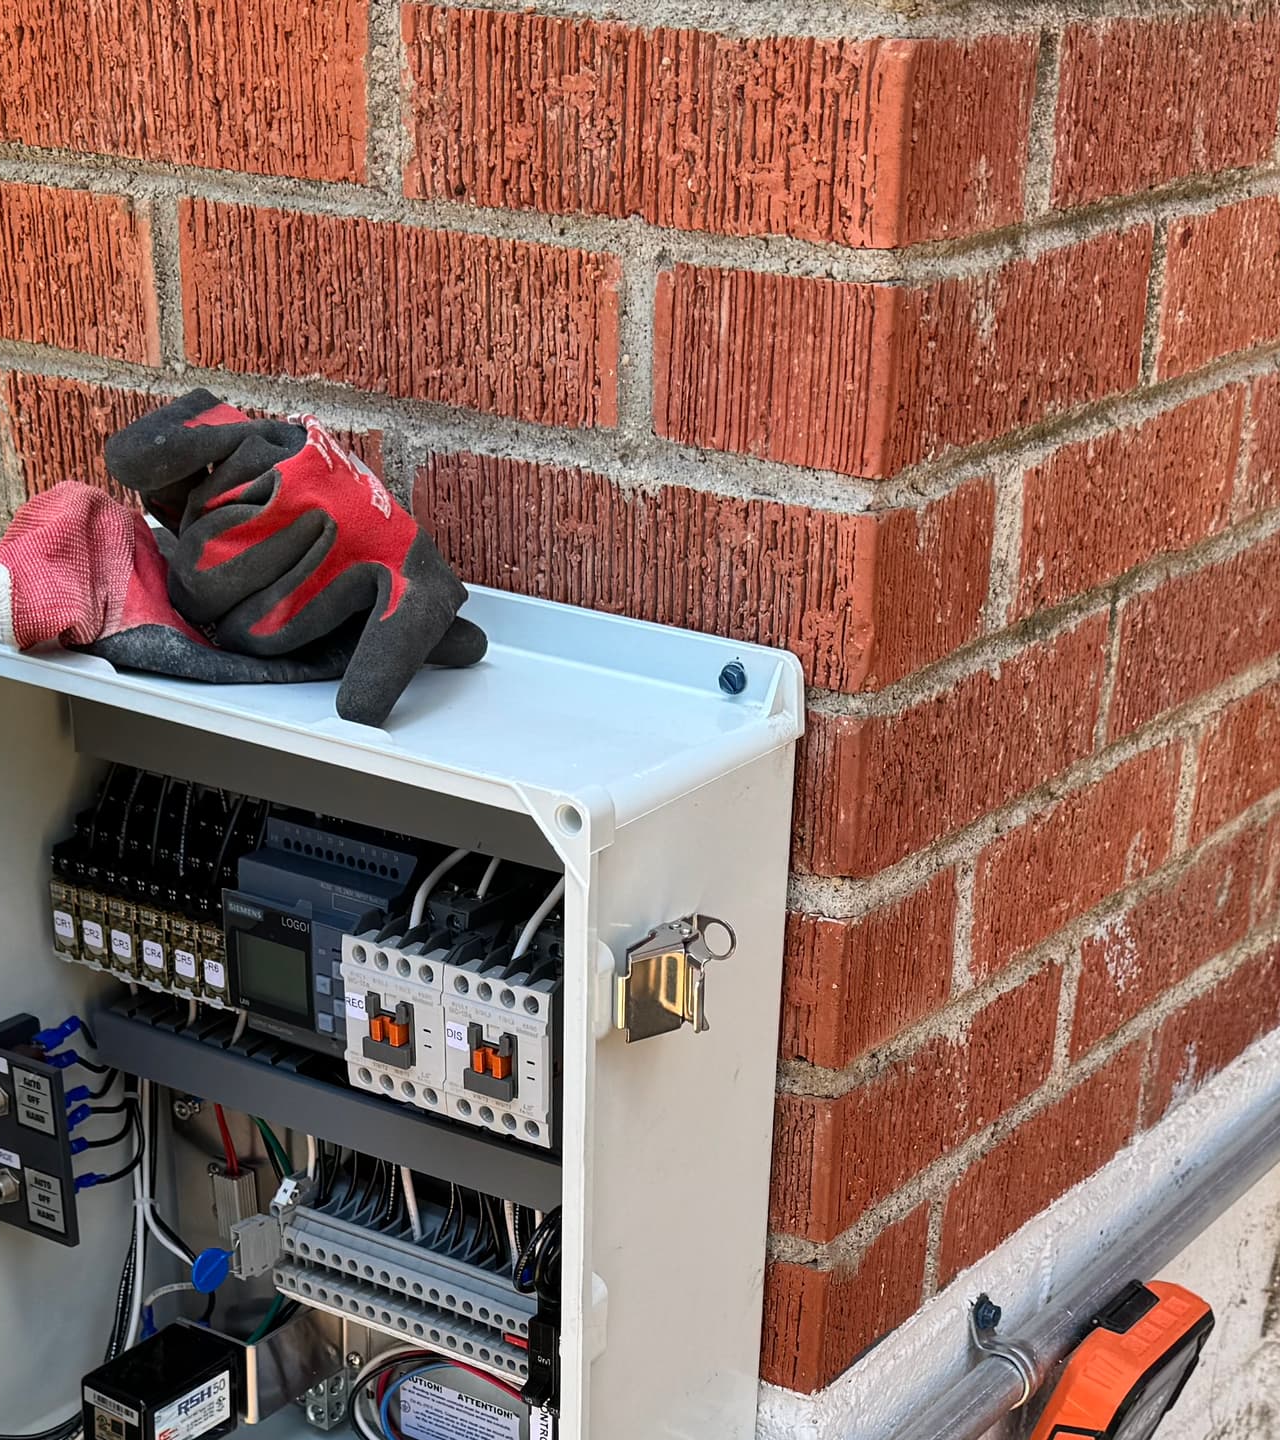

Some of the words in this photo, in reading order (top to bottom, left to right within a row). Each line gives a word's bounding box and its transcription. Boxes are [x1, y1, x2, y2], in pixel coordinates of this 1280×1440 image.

[229, 903, 264, 919] SIEMENS
[55, 917, 71, 929] CR1
[84, 927, 100, 939] CR2
[113, 938, 130, 951] CR3
[145, 947, 162, 959] CR4
[176, 952, 193, 965] CR5
[446, 1028, 463, 1041] DIS
[23, 1077, 42, 1090] AUTO
[27, 1094, 41, 1106] OFF
[34, 1177, 52, 1190] AUTO
[38, 1193, 51, 1205] OFF
[457, 1393, 513, 1421] ATTENTION!
